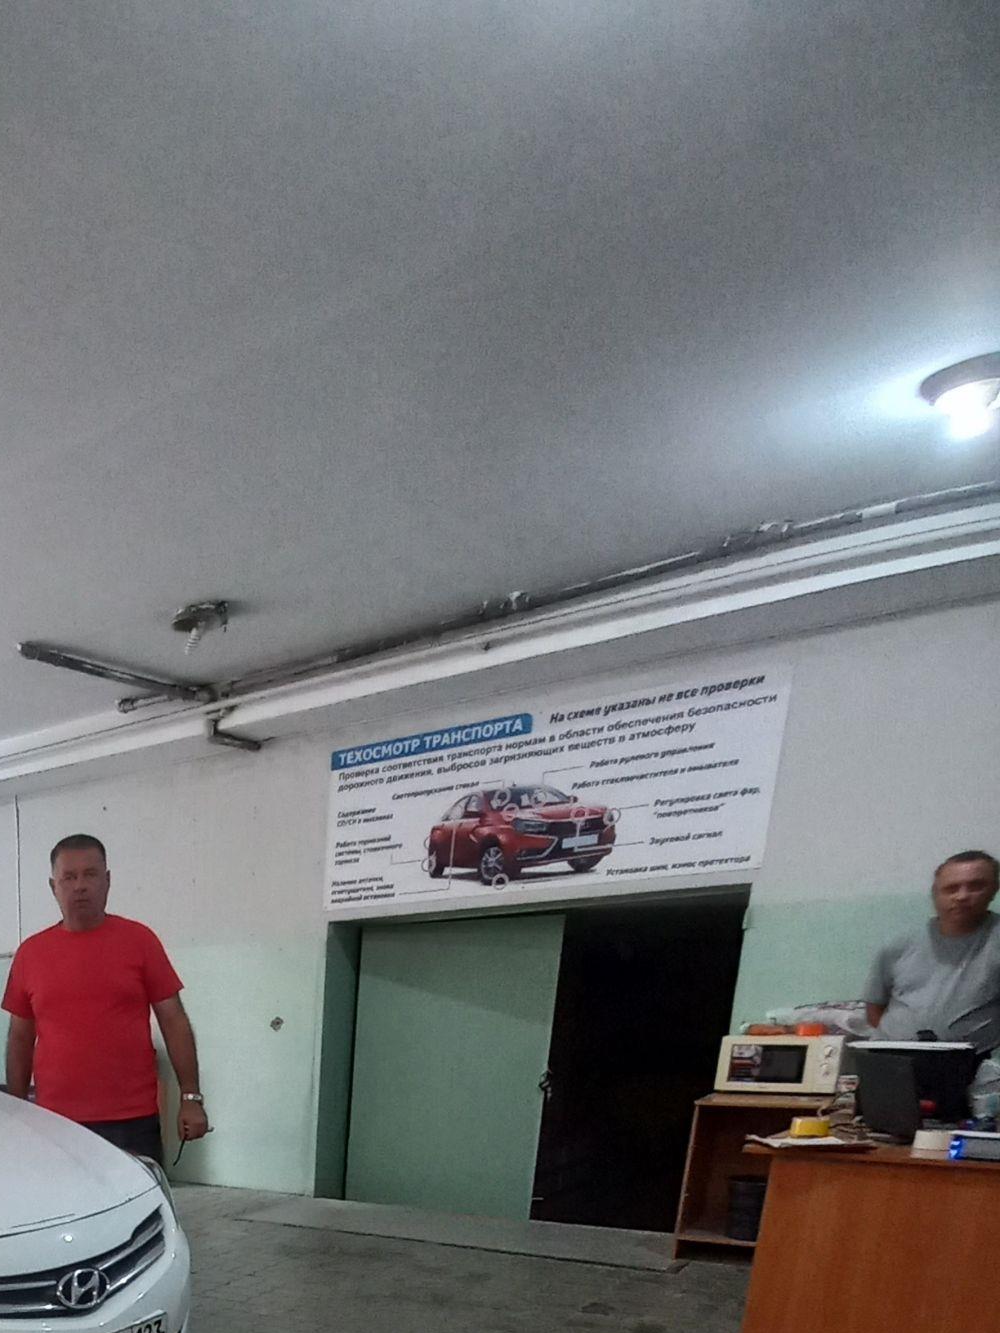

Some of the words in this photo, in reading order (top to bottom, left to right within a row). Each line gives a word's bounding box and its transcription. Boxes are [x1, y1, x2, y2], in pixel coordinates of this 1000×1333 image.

[549, 712, 565, 724] На
[567, 707, 601, 721] схеме
[603, 697, 656, 716] указаны
[658, 693, 674, 703] не
[676, 689, 699, 701] все
[700, 674, 766, 696] проверки
[337, 778, 385, 793] дорожного
[436, 759, 486, 774] выбросов
[489, 746, 565, 765] загрязняющих
[568, 737, 615, 752] веществ
[618, 735, 626, 743] в
[628, 721, 696, 742] атмосферу
[339, 767, 380, 781] Проверка
[382, 756, 445, 773] соответствия
[447, 745, 503, 762] транспорта
[505, 737, 546, 752] нормам
[549, 735, 556, 743] в
[558, 727, 605, 741] области
[607, 711, 684, 733] обеспечения
[687, 693, 778, 718] безопасности
[339, 737, 421, 766] ТЕХОСМОТР
[424, 718, 523, 749] ТРАНСПОРТА
